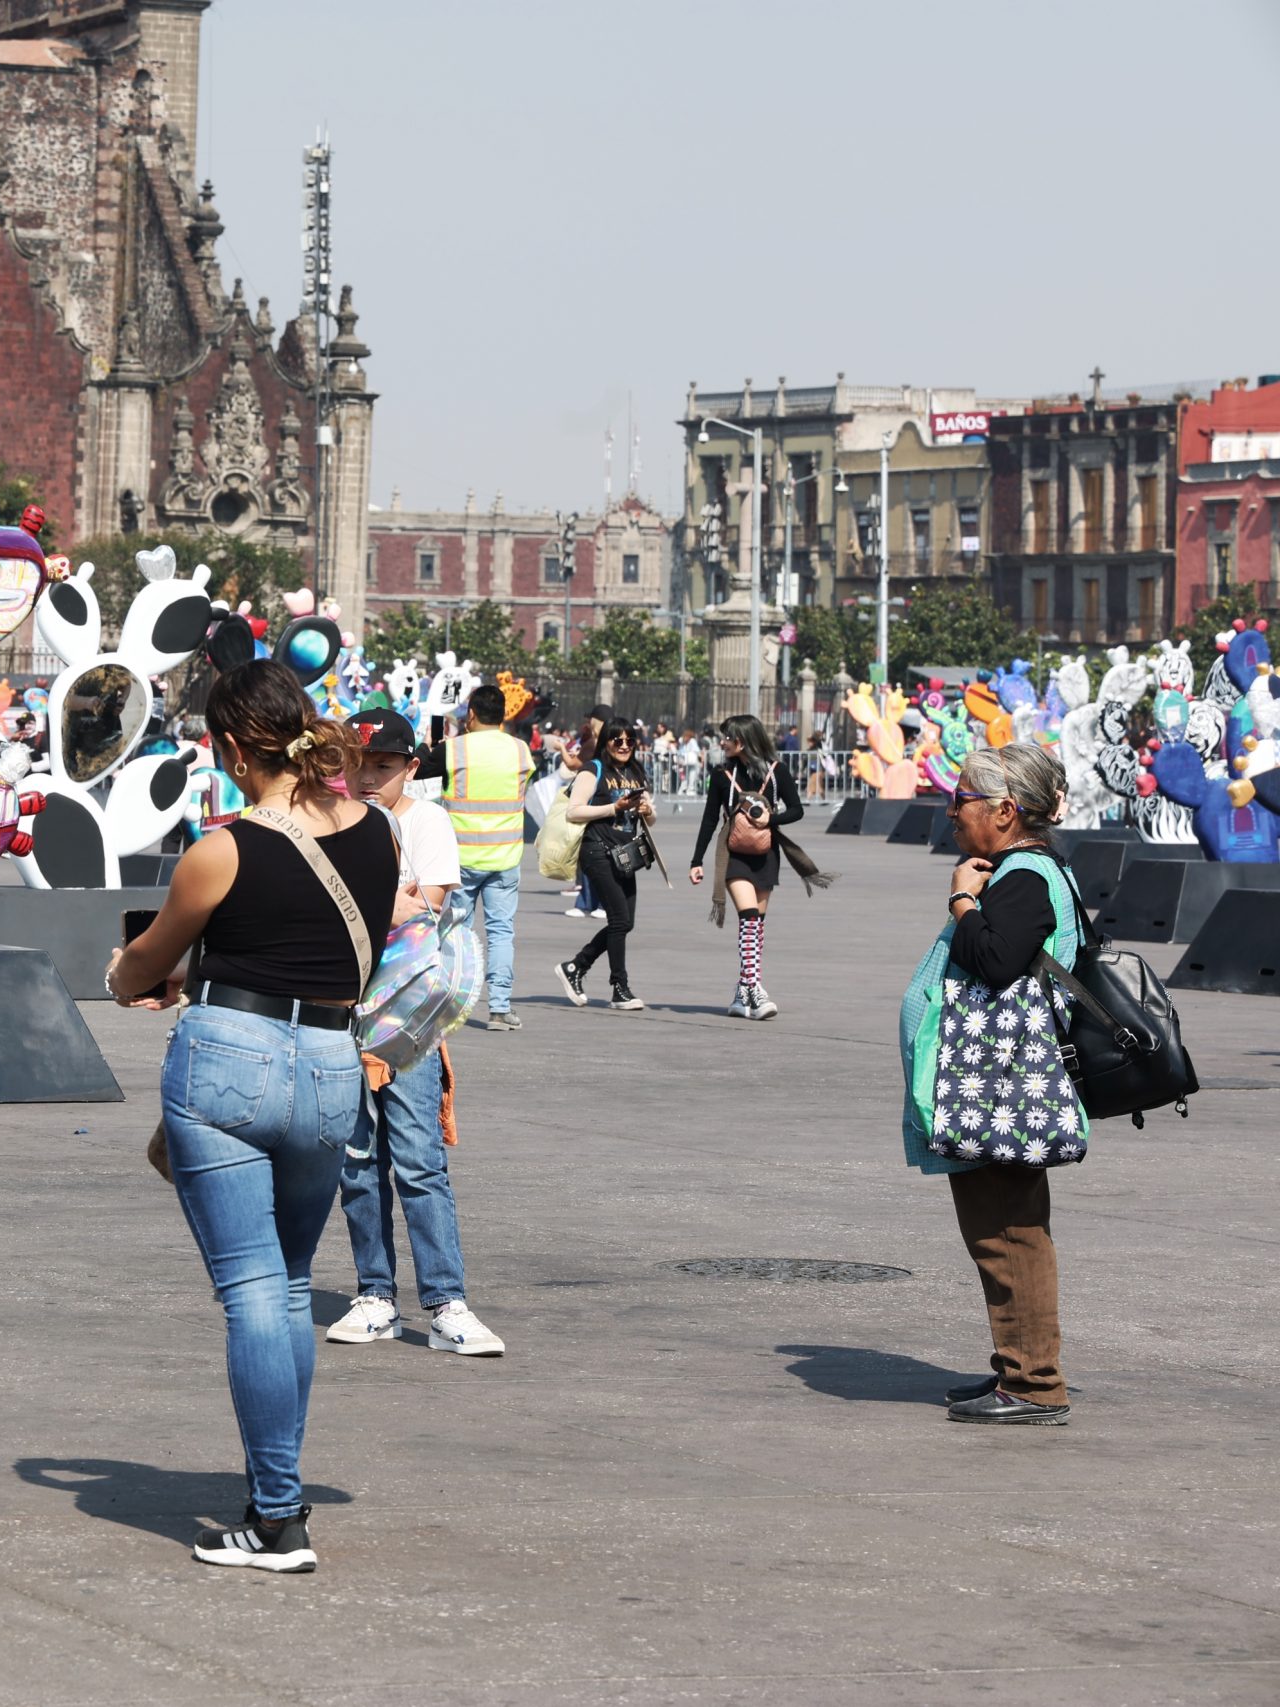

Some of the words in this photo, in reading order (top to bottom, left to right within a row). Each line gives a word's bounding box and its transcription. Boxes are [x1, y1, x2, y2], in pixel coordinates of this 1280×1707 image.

[935, 413, 988, 432] BAÑOS
[255, 807, 304, 840] GUESS
[326, 874, 358, 923] GUESS
